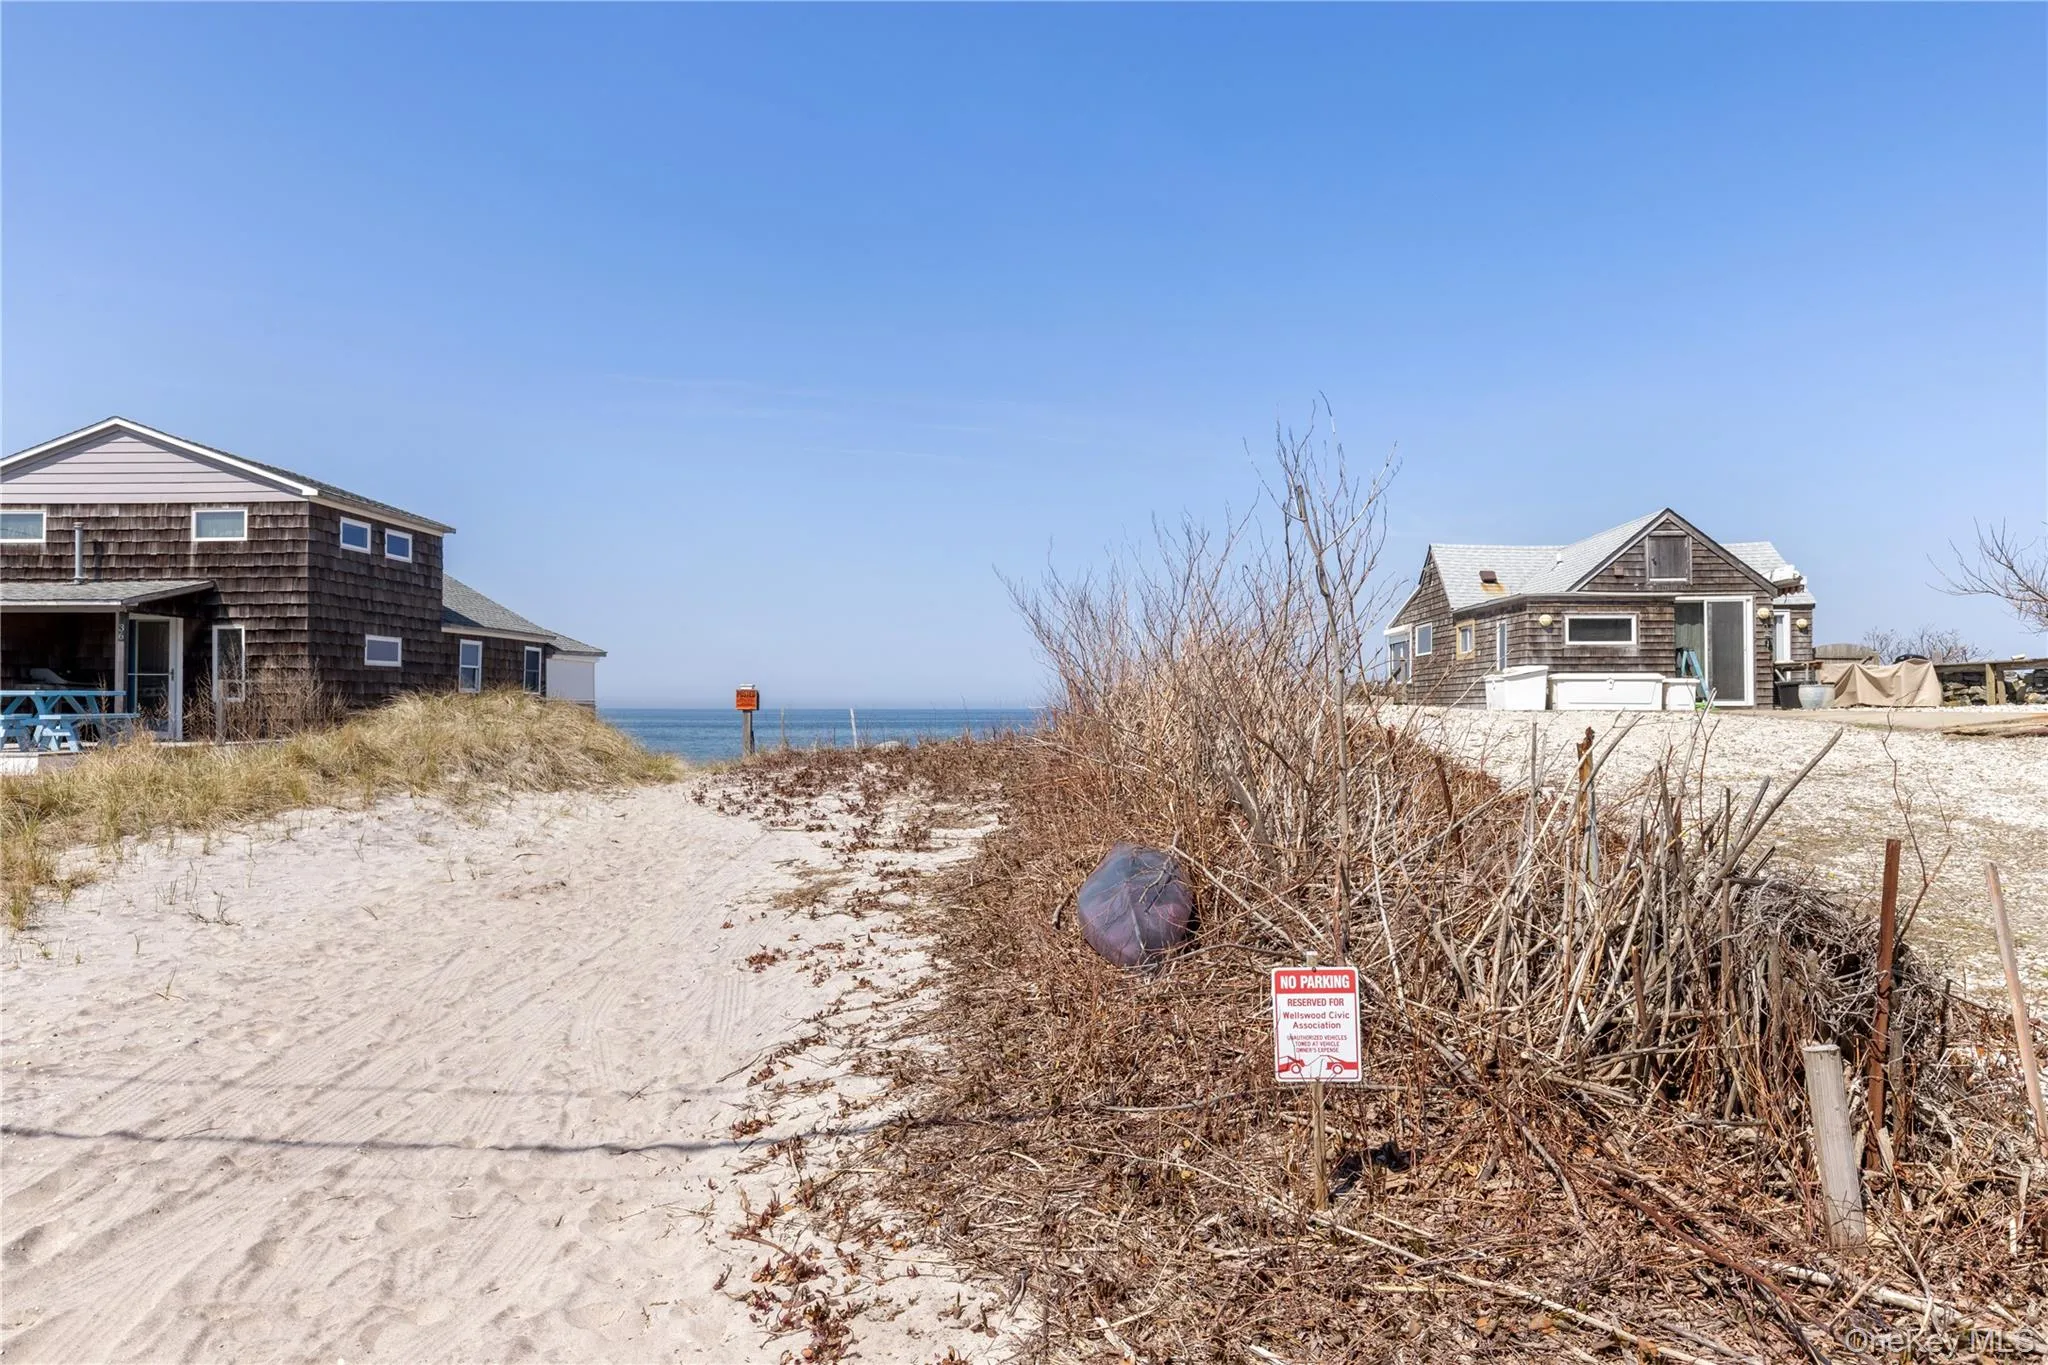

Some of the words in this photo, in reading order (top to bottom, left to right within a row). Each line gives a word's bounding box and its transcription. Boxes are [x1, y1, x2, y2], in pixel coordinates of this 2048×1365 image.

[1280, 975, 1297, 989] NO
[1300, 975, 1350, 989] PARKING
[1287, 998, 1327, 1006] RESERVED
[1329, 998, 1344, 1006] FOR
[1283, 1011, 1326, 1019] Wellswood
[1329, 1011, 1350, 1019] Civic
[1292, 1021, 1341, 1029] Association
